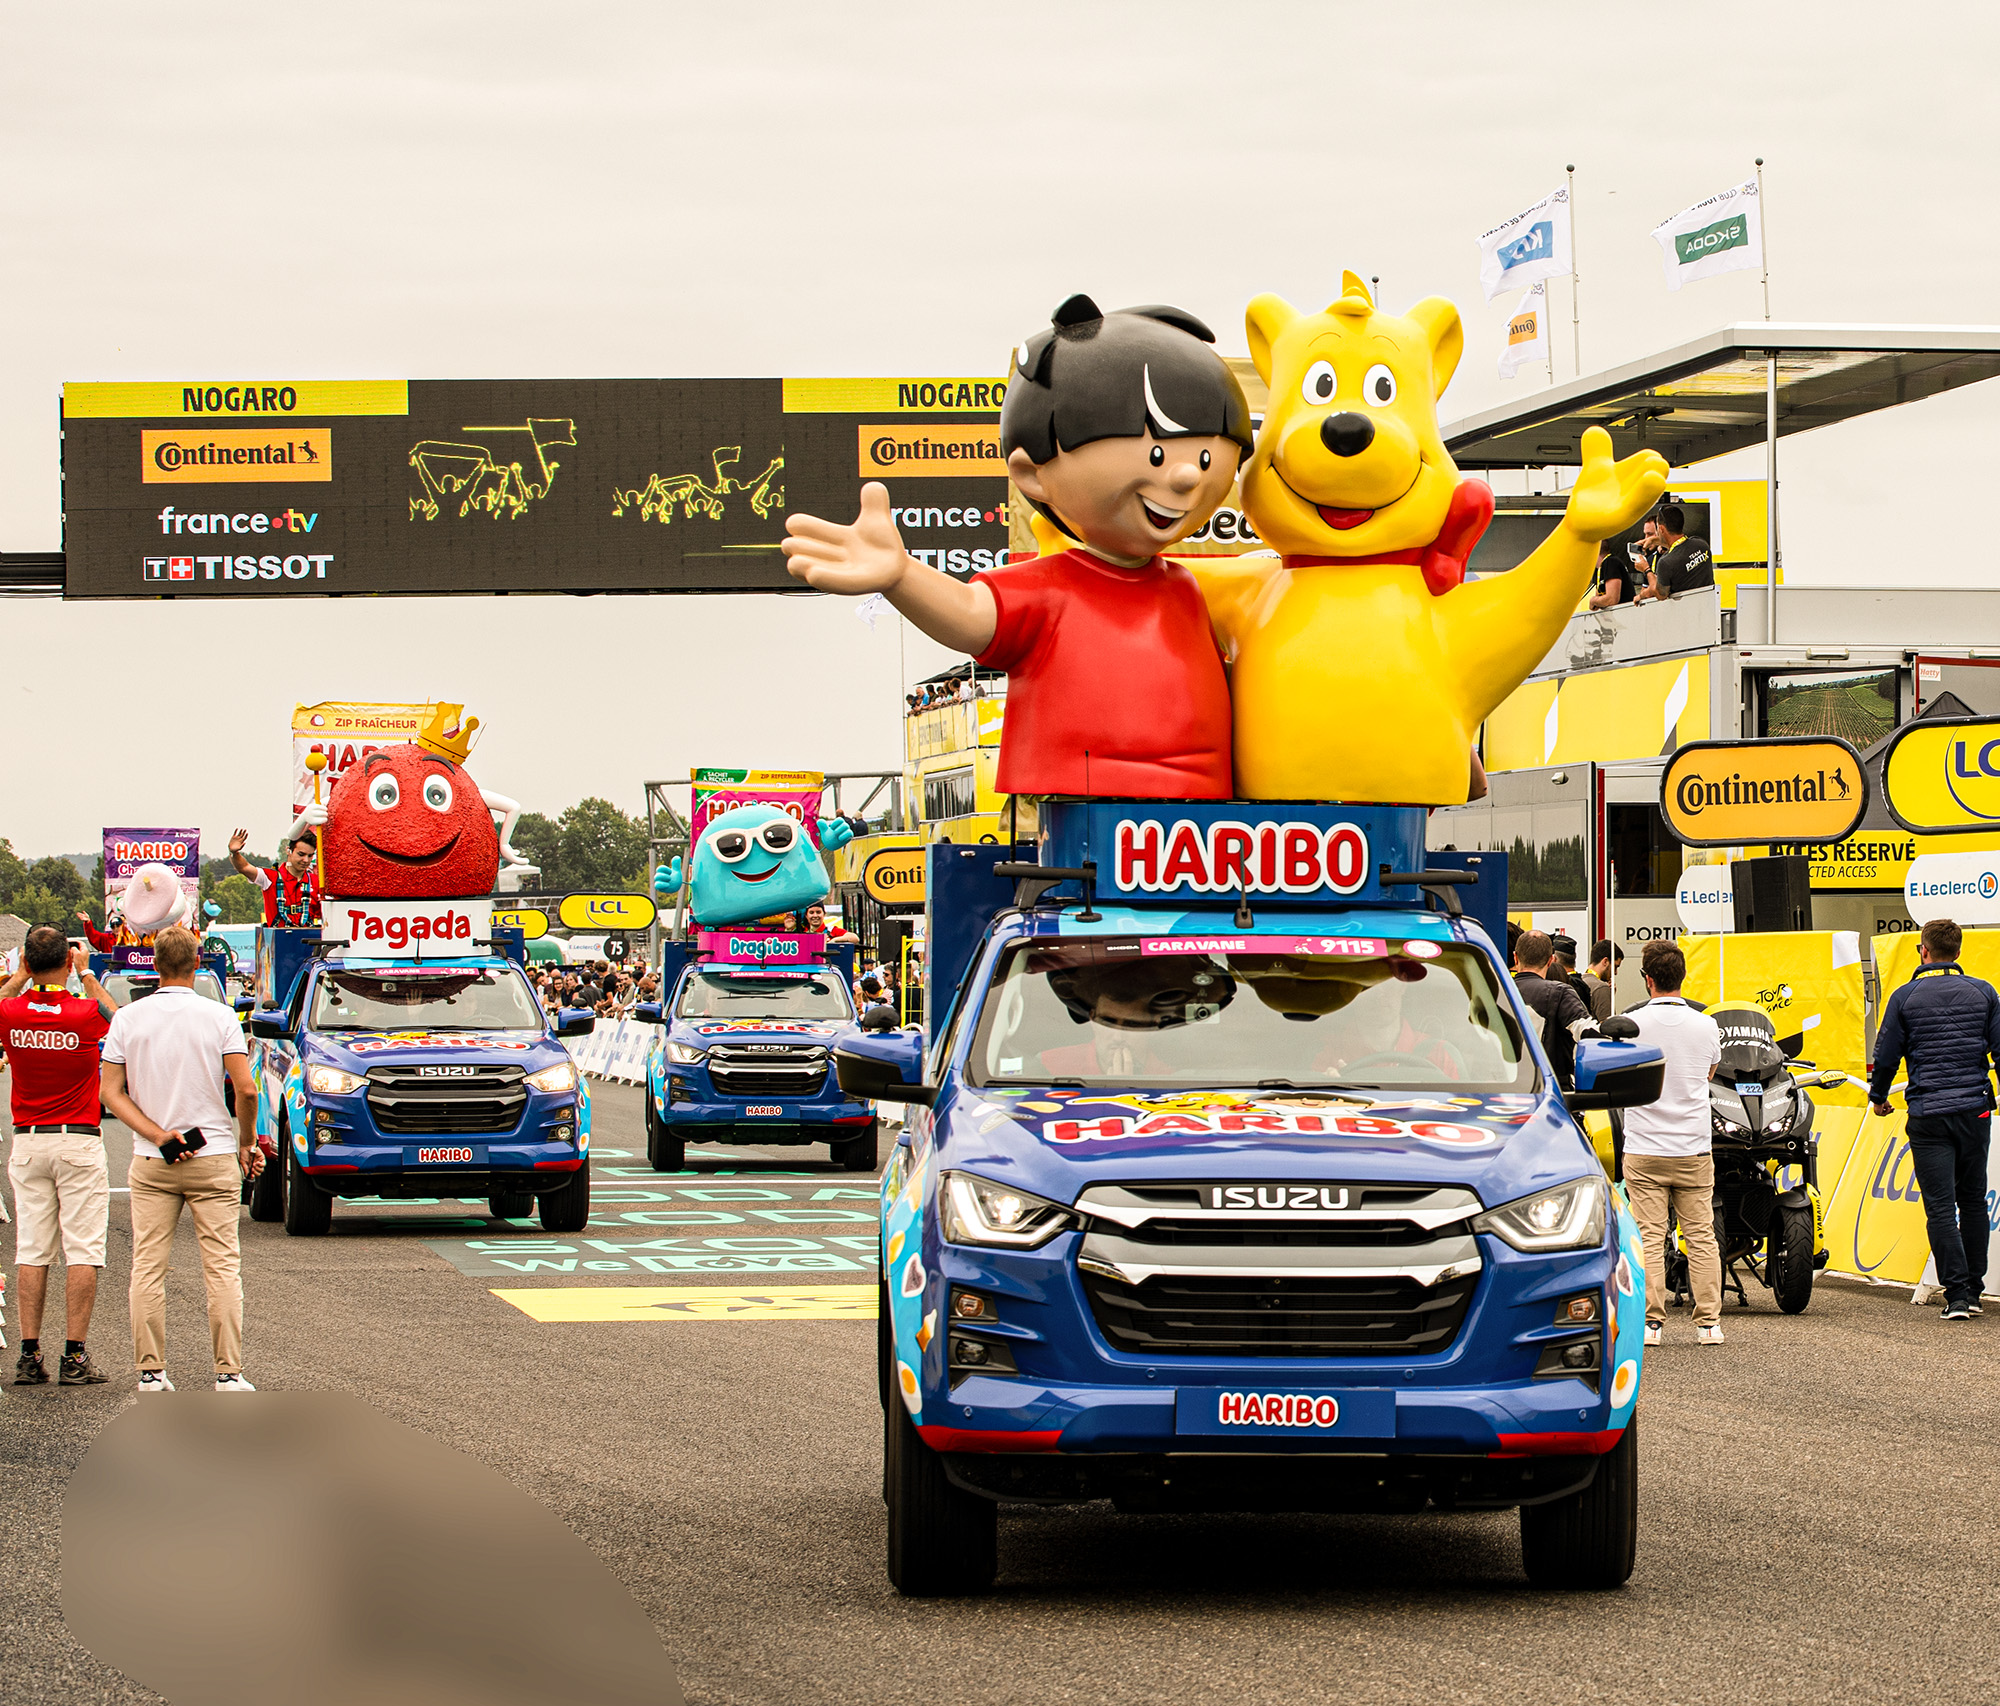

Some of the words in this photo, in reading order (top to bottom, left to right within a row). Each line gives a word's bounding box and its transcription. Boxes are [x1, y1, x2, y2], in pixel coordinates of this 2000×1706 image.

[183, 387, 297, 412] NOGARO
[899, 383, 1007, 407] NOGARO
[155, 441, 296, 472] Continental
[912, 549, 1009, 573] TISS
[1685, 550, 1709, 573] PORTIX
[1689, 550, 1702, 560] TEAM
[197, 555, 334, 580] TISSOT
[335, 718, 352, 727] ZIP
[355, 717, 417, 729] FRAÎCHEUR
[1955, 739, 2000, 779] LC
[1677, 770, 1826, 816] Continental
[115, 842, 188, 861] HARIBO
[1115, 820, 1369, 893] HARIBO
[1834, 839, 1916, 861] RÉSERVÉ
[874, 866, 925, 889] Conti
[1838, 866, 1877, 878] ACCESS
[1681, 890, 1733, 904] E.Lecler
[1910, 881, 1976, 897] E.Leclerc
[590, 901, 629, 914] LCL
[348, 909, 471, 949] Tagada
[493, 915, 526, 926] LCL
[1626, 927, 1688, 941] PORTIX
[611, 941, 623, 956] 75
[730, 937, 798, 959] Dragibus
[1148, 940, 1246, 951] CARAVANE
[1320, 939, 1375, 954] 9115
[1756, 983, 1787, 1004] TOUR
[10, 1029, 79, 1050] HARIBO
[349, 1037, 531, 1052] HARIBO
[1724, 1026, 1770, 1044] YAMAHA
[419, 1067, 475, 1076] ISUZU
[1746, 1085, 1762, 1093] 222
[746, 1106, 782, 1116] HARIBO
[1717, 1098, 1742, 1109] YAMAHA
[1043, 1114, 1496, 1146] HARIBO
[418, 1147, 474, 1164] HARIBO
[1212, 1186, 1349, 1209] ISUZU
[1219, 1392, 1339, 1428] HARIBO
